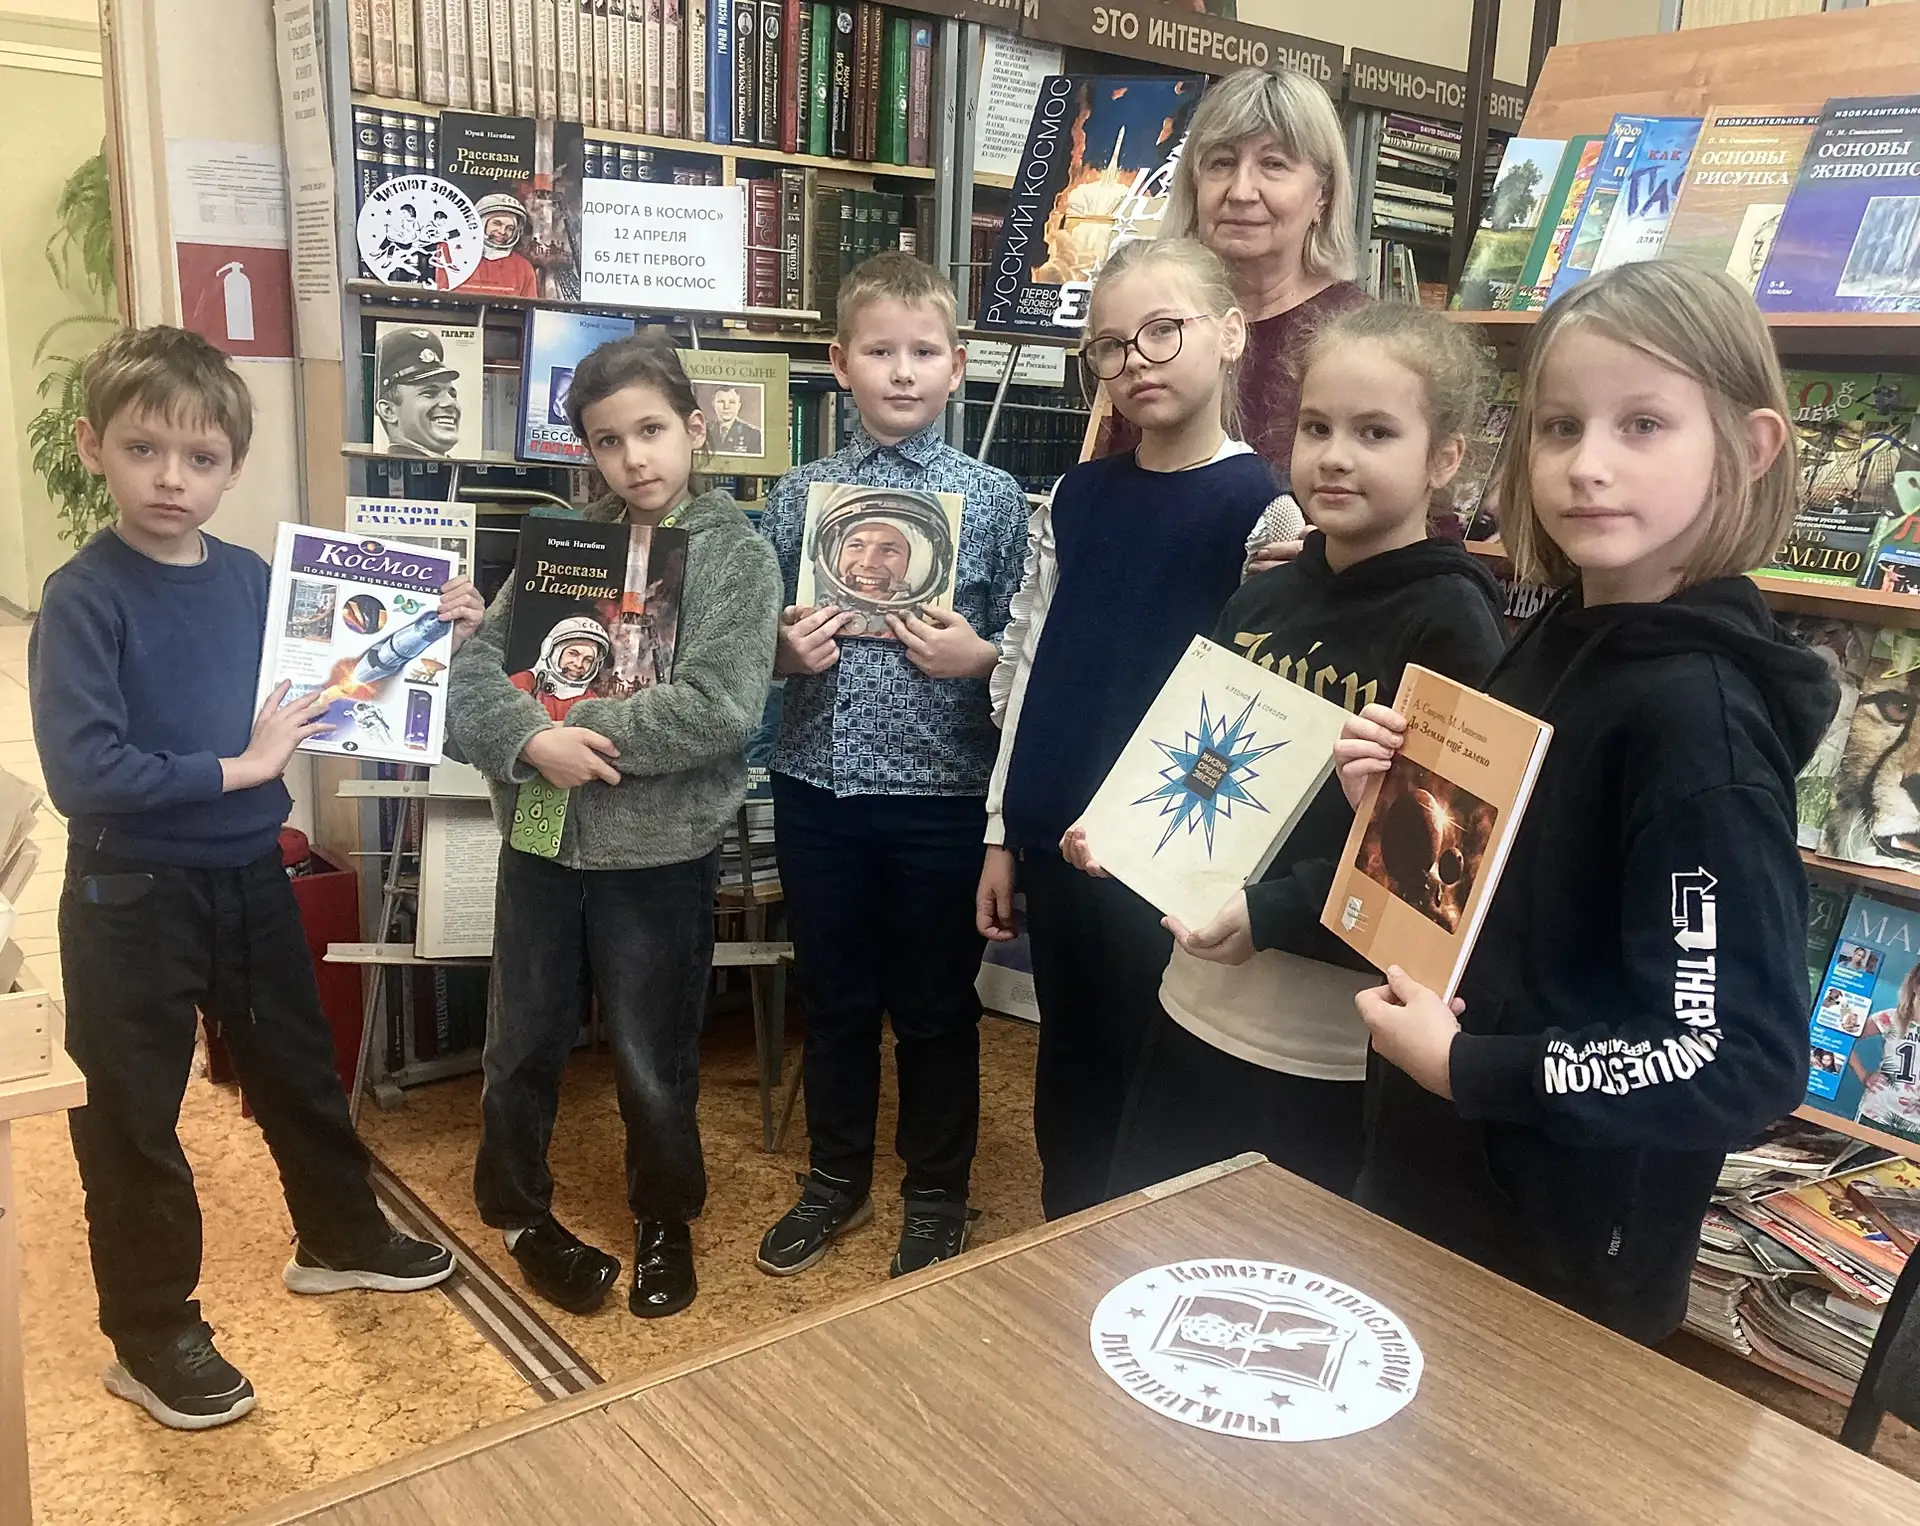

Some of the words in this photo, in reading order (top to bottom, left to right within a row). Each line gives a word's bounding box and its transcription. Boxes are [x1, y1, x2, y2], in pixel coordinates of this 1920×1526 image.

[1092, 7, 1139, 40] ЭТО
[1149, 17, 1268, 67] ИНТЕРЕСНО
[1278, 46, 1332, 81] ЗНАТЬ
[464, 129, 485, 138] Юрий
[487, 131, 516, 141] Нагибин
[456, 147, 520, 164] Рассказы
[1701, 149, 1790, 166] ОСНОВЫ
[1818, 140, 1913, 158] ОСНОВЫ
[449, 164, 458, 174] о
[461, 159, 530, 181] Гагарине
[1693, 170, 1790, 186] РИСУНКА
[583, 201, 640, 217] ДОРОГА
[644, 206, 652, 217] В
[656, 207, 724, 221] КОСМОС»
[986, 204, 1038, 325] РУССКИЙ
[1021, 78, 1072, 197] КОСМОС
[613, 228, 629, 240] 12
[633, 230, 687, 243] АПРЕЛЯ
[594, 250, 610, 263] 65
[614, 252, 640, 265] ЛЕТ
[643, 254, 706, 267] ПЕРВОГО
[788, 233, 798, 281] СЛОВАРЬ
[584, 271, 640, 286] ПОЛЕТА
[644, 275, 651, 286] В
[655, 276, 717, 289] КОСМОС
[739, 367, 777, 379] СЫНЕ
[356, 515, 469, 528] ГАГАРИНА
[547, 537, 570, 548] Юрий
[573, 540, 606, 551] Нагибин
[316, 542, 434, 581] Космос
[535, 559, 609, 580] Рассказы
[524, 580, 536, 592] о
[539, 575, 619, 601] Гагарине
[1406, 715, 1419, 730] До
[1462, 748, 1490, 768] далеко
[1197, 761, 1223, 781] СРЕДИ
[1200, 751, 1229, 773] ЖИЗНЬ
[1192, 769, 1218, 789] ЗВЕЗД
